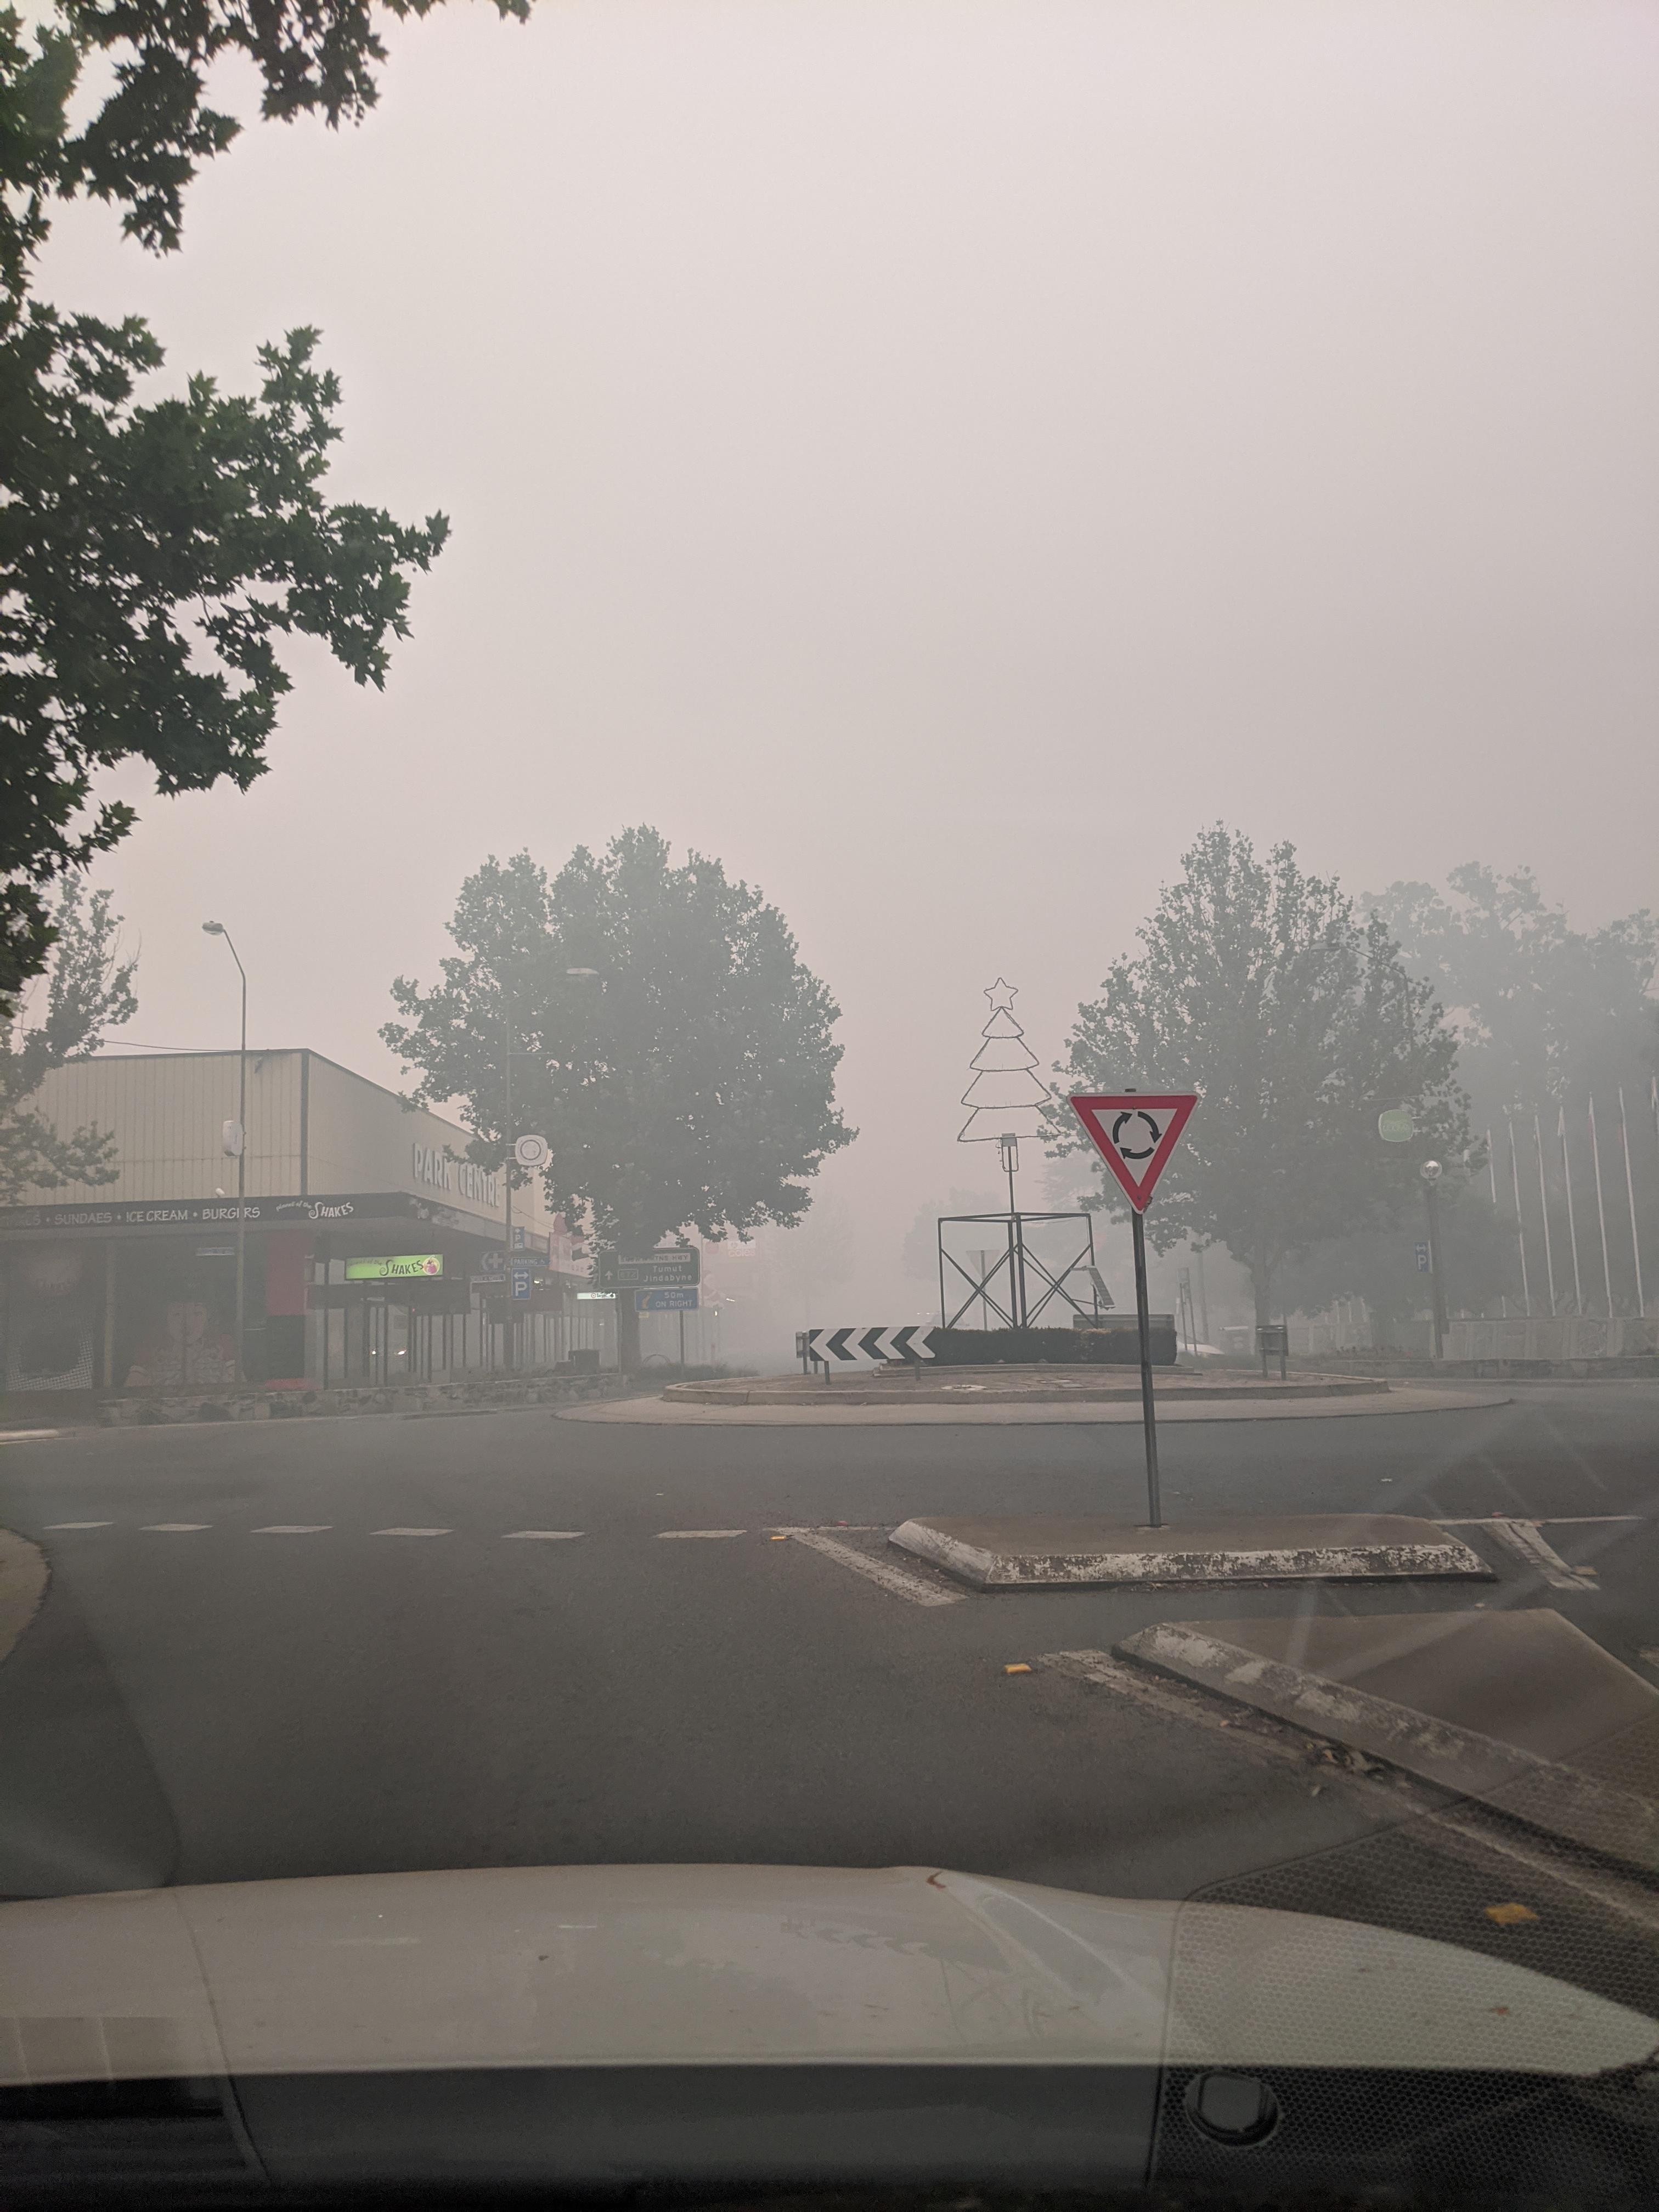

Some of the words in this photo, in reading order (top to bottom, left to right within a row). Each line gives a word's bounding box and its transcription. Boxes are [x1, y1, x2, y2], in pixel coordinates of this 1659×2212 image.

[413, 1142, 451, 1190] PARK
[458, 1162, 500, 1208] CENTRE
[54, 1212, 112, 1225] SUNDAES
[126, 1211, 144, 1222] ICE
[146, 1210, 188, 1222] CREAM
[308, 1201, 354, 1220] SHAKES
[379, 1259, 424, 1276] SHAKES
[653, 1265, 682, 1273] Tumut
[1418, 1255, 1427, 1269] P
[643, 1274, 692, 1283] Jindabyne
[515, 1282, 527, 1296] P
